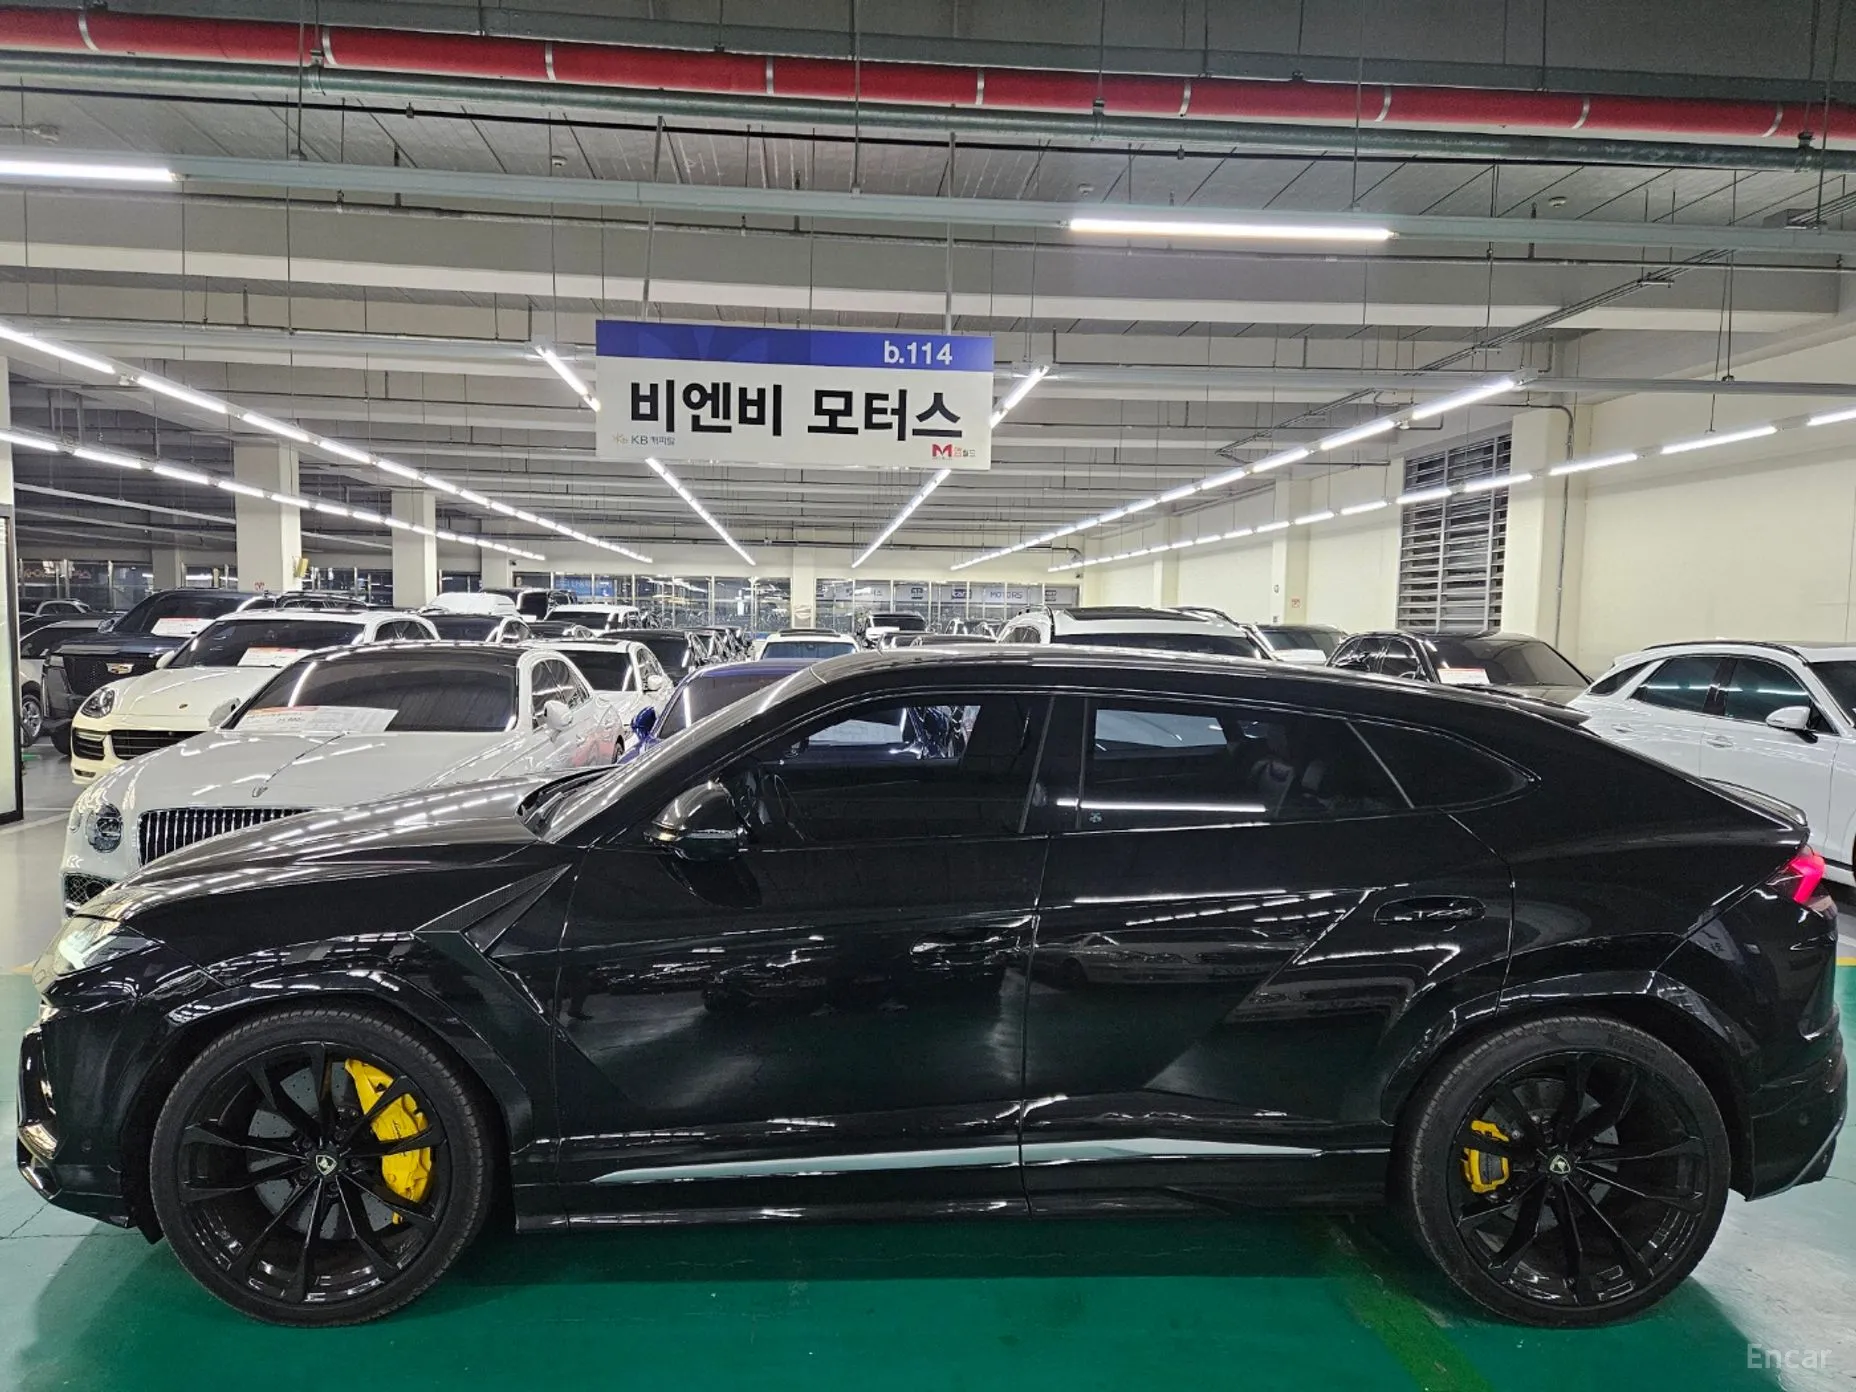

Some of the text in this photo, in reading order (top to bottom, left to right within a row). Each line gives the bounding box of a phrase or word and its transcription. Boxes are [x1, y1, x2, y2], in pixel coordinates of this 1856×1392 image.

[884, 340, 952, 365] b.114
[631, 379, 963, 441] 비엔비 모터스
[631, 435, 648, 445] KB
[990, 591, 1023, 599] MOORS
